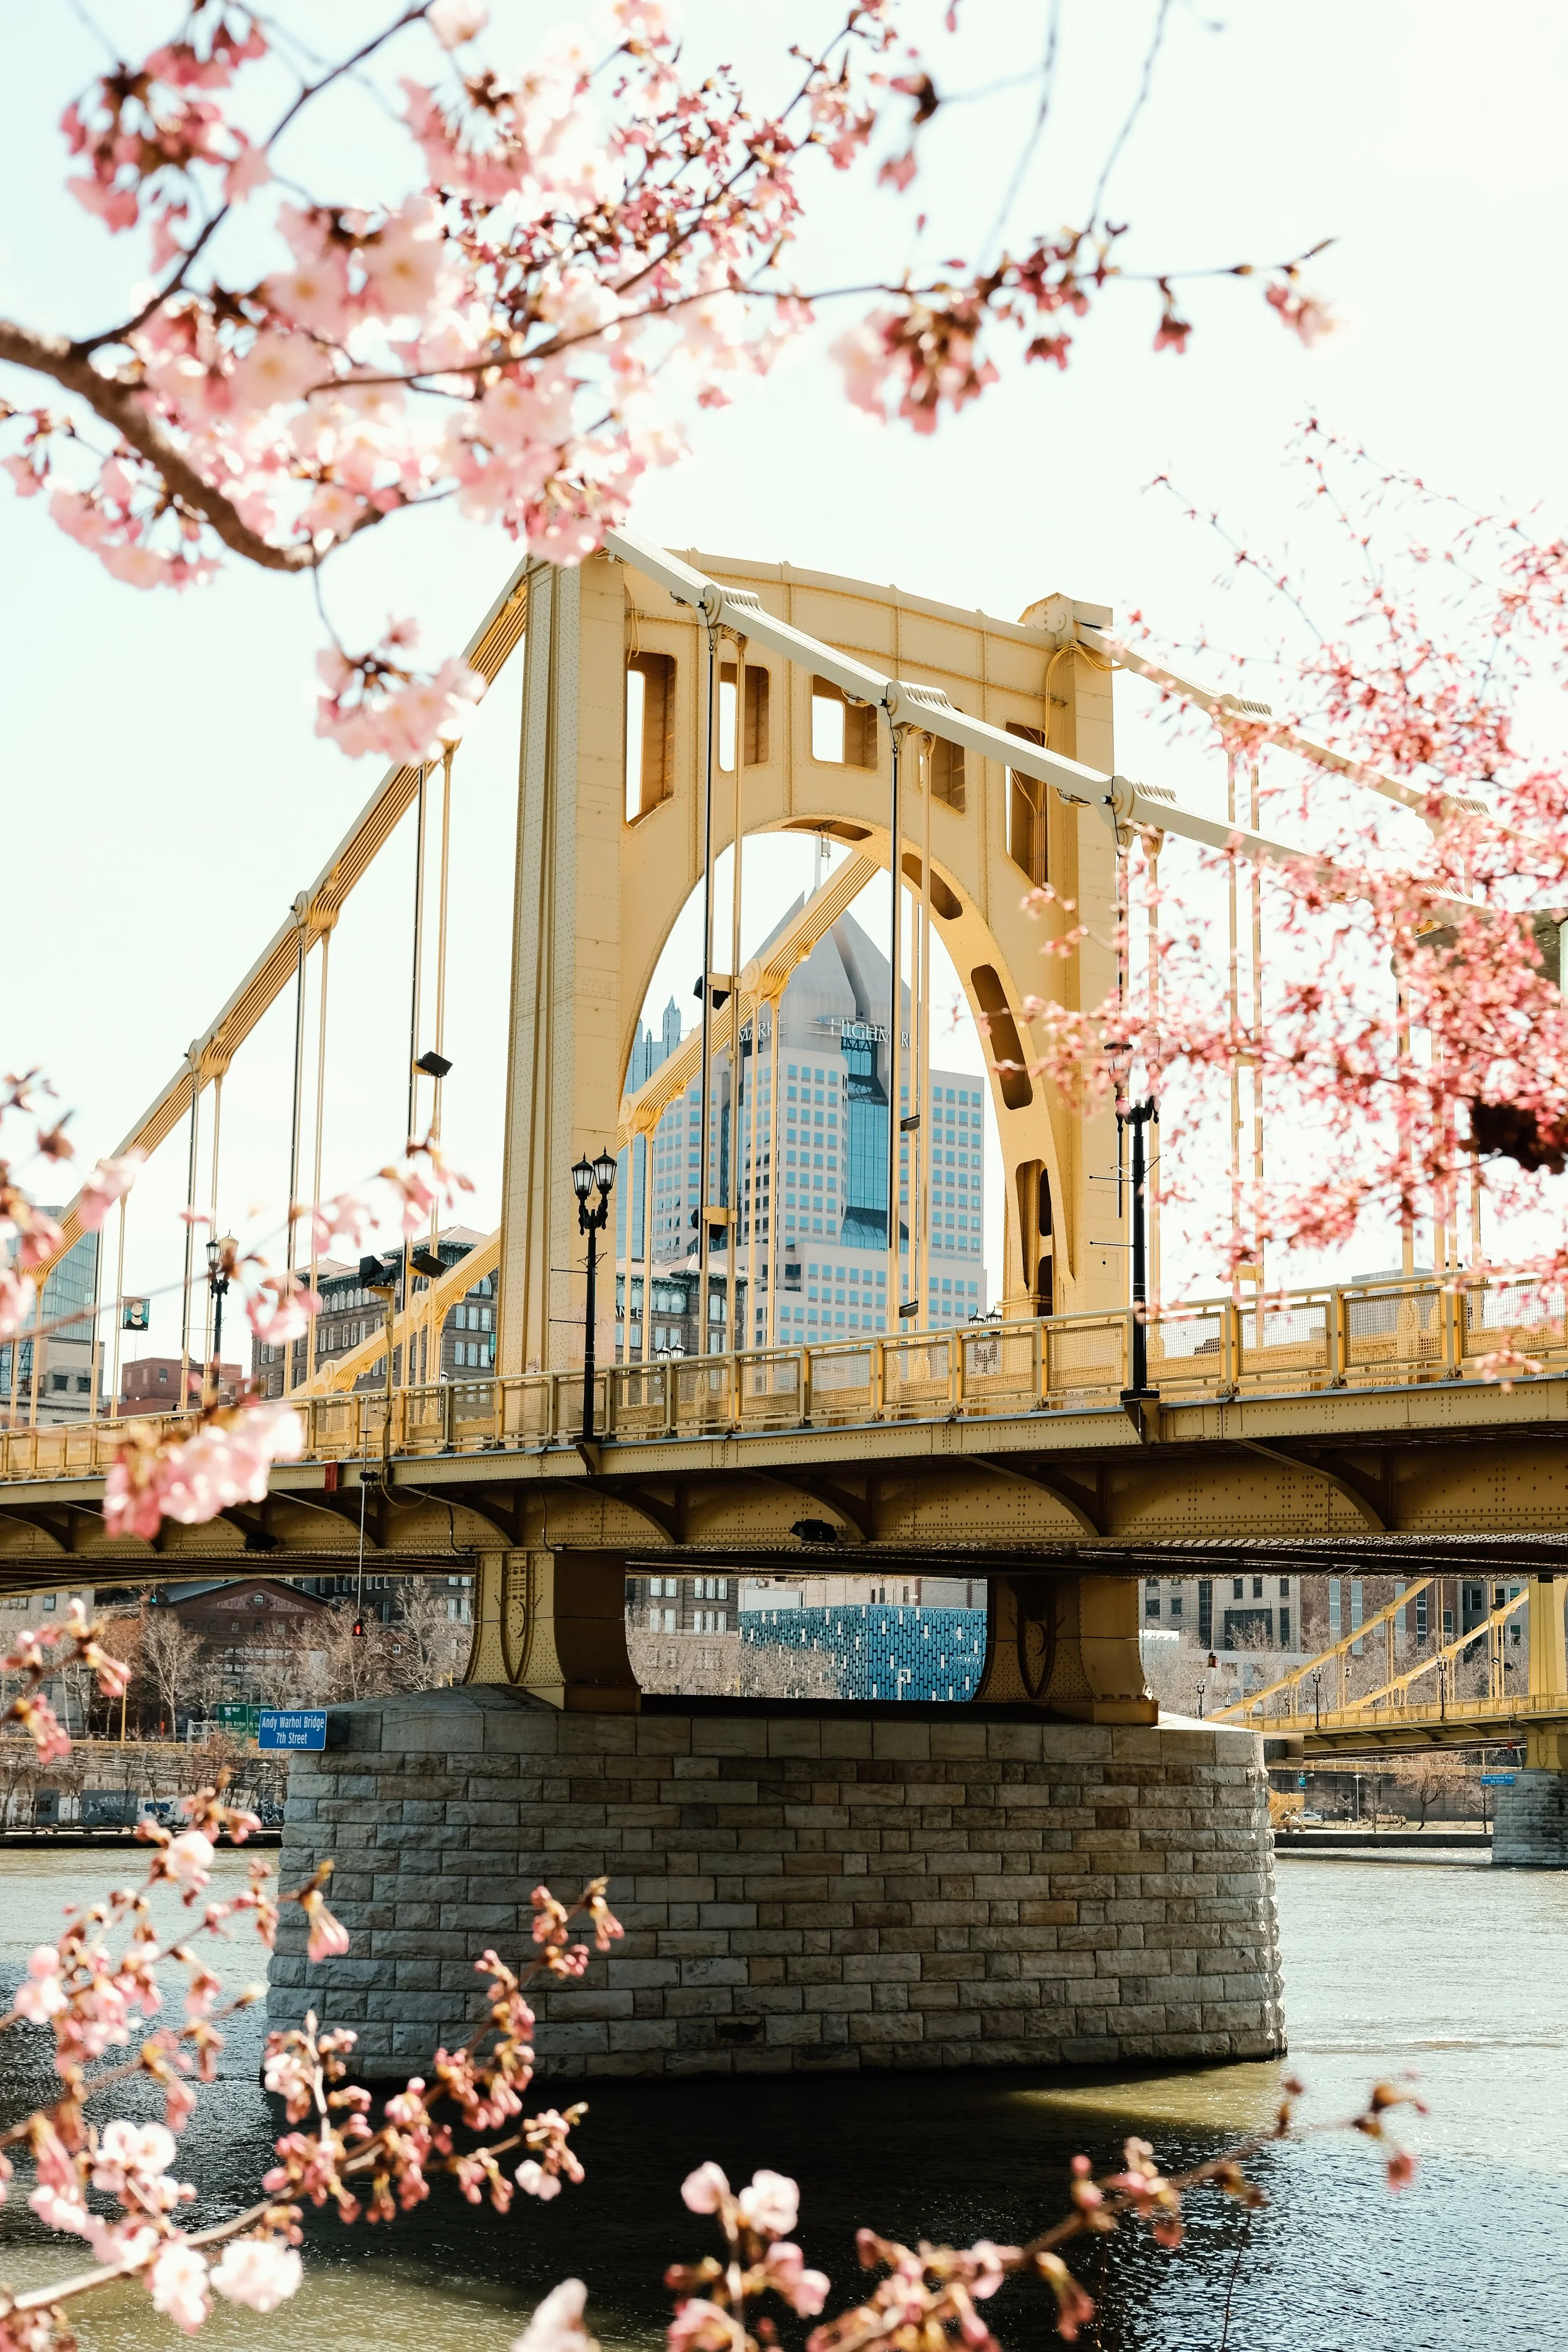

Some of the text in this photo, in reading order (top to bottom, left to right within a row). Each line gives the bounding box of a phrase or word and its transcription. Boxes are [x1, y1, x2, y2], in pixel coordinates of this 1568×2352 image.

[831, 1018, 912, 1048] HIGHMR
[261, 1715, 324, 1731] Andy Warhol Bridge
[276, 1732, 308, 1744] 7th Street
